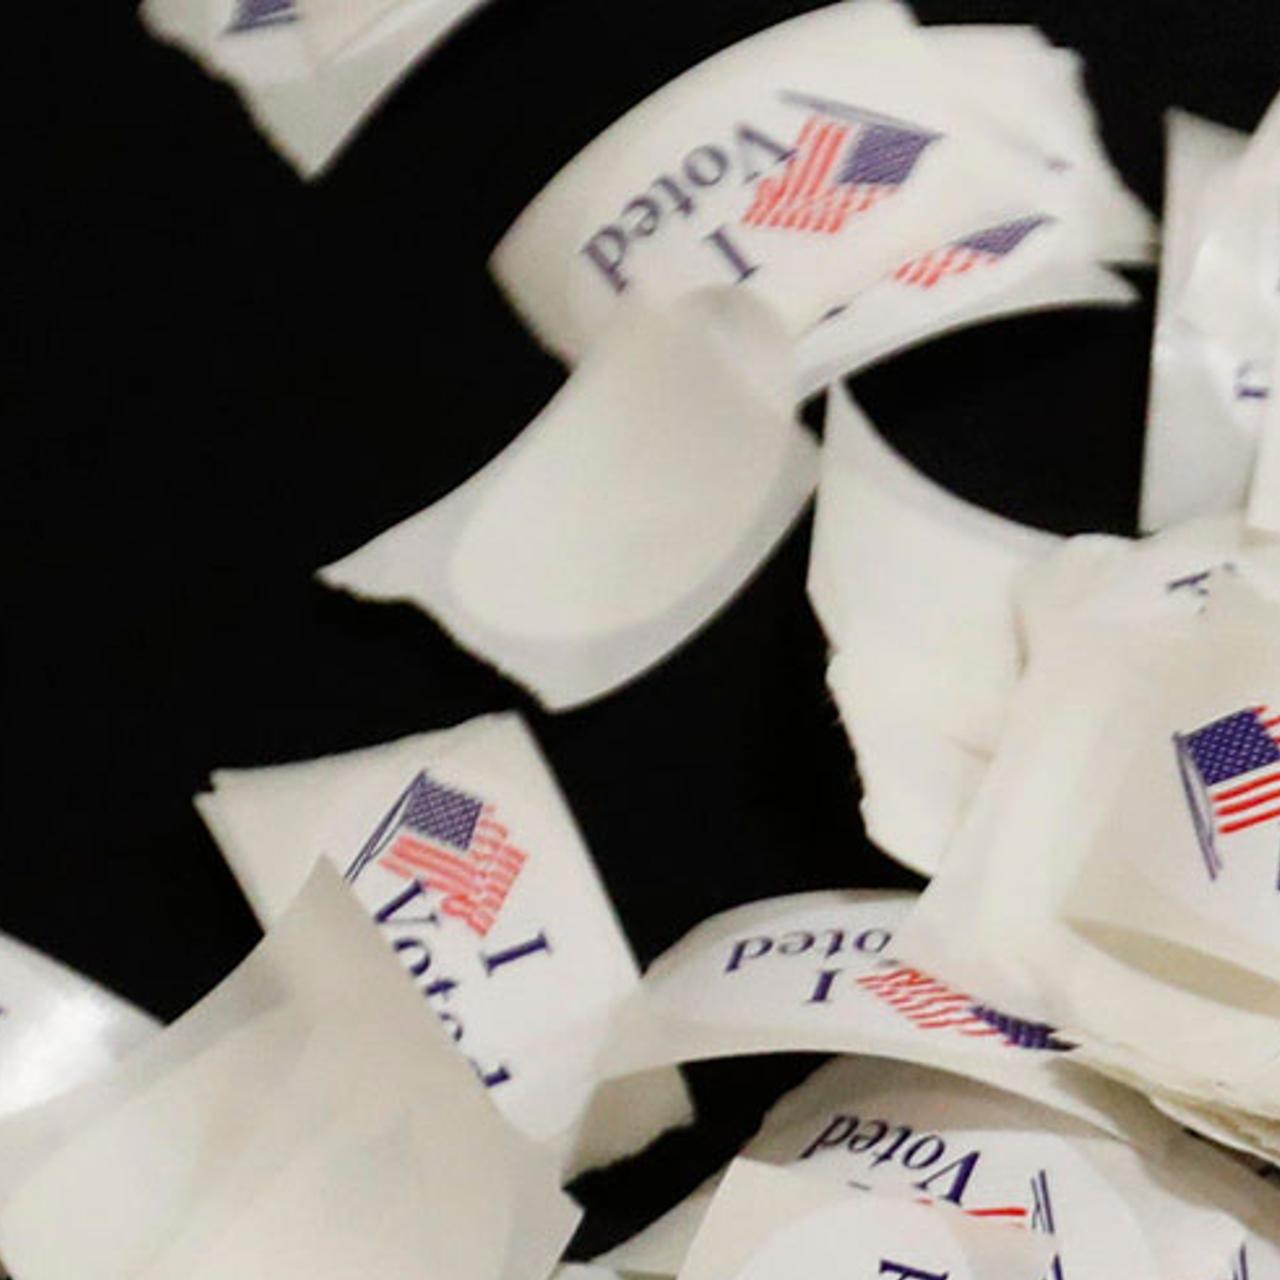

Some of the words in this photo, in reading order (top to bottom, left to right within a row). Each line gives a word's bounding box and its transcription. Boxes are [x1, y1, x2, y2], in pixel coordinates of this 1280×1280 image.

[580, 118, 798, 295] Voted
[701, 229, 761, 284] I
[479, 931, 555, 977] I
[724, 926, 896, 974] oted
[808, 967, 841, 1005] I
[800, 1113, 982, 1207] Voted
